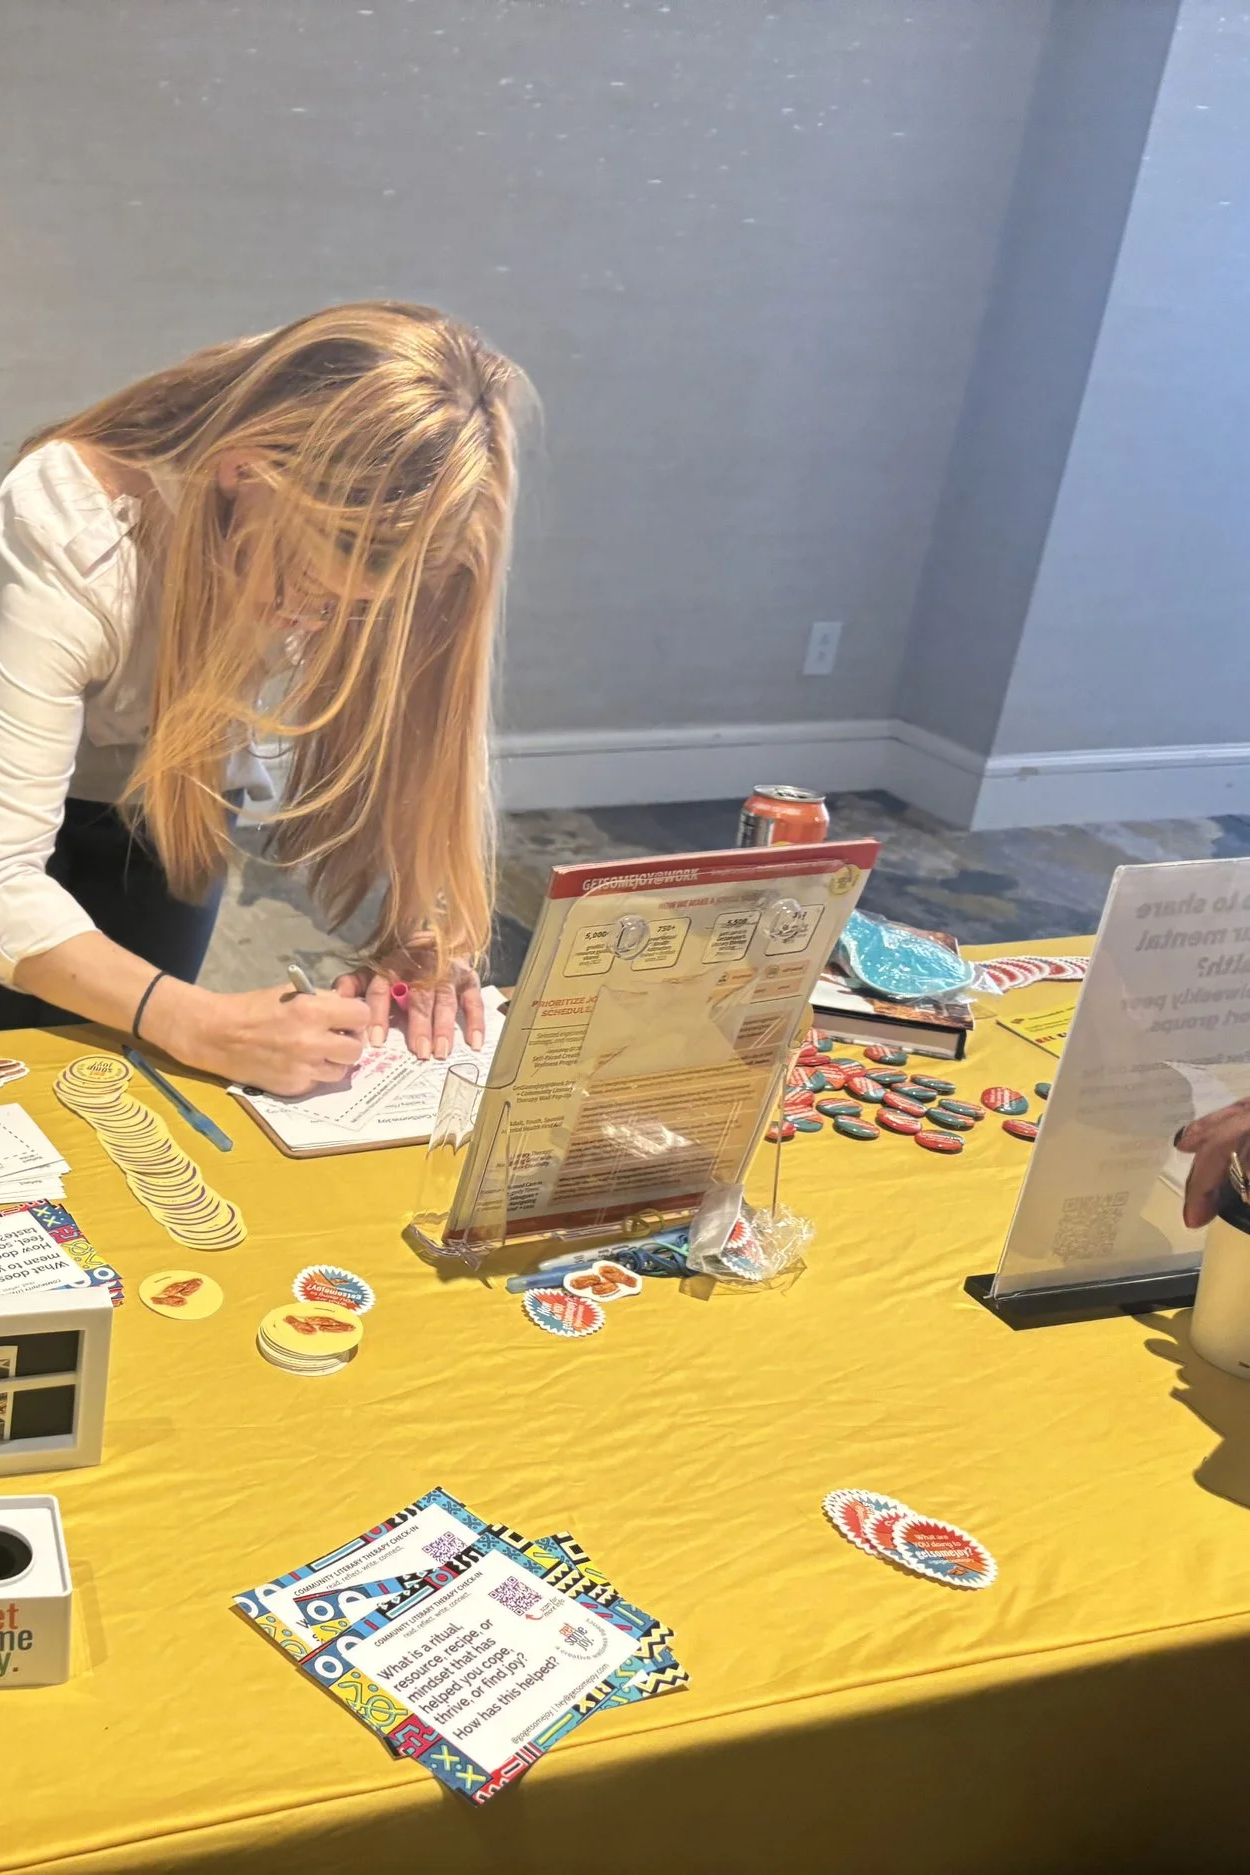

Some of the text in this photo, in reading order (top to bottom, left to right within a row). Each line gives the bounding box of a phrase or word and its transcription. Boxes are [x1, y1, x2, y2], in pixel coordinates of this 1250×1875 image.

[6, 1261, 23, 1270] to
[13, 1233, 44, 1246] feel,
[21, 1241, 52, 1254] How
[22, 1251, 61, 1266] mean
[30, 1260, 69, 1274] What
[293, 1524, 419, 1598] COMMUNITY LITERARY THERAPY CHECK-IN
[373, 1570, 483, 1647] COMMUNITY LITERARY THERAPY CHECK-IN
[558, 1621, 577, 1637] get
[563, 1625, 588, 1646] some
[376, 1622, 464, 1680] What is a ritual,
[393, 1617, 493, 1692] resource, recipe, or
[407, 1636, 496, 1703] mindset that has
[575, 1635, 595, 1652] joy.
[418, 1646, 514, 1714] helped you cope,
[432, 1651, 528, 1725] thrive, or find joy?
[451, 1655, 559, 1740] How has this helped?
[510, 1662, 609, 1744] @gogetsomejoy hey@getsomejoy.com
